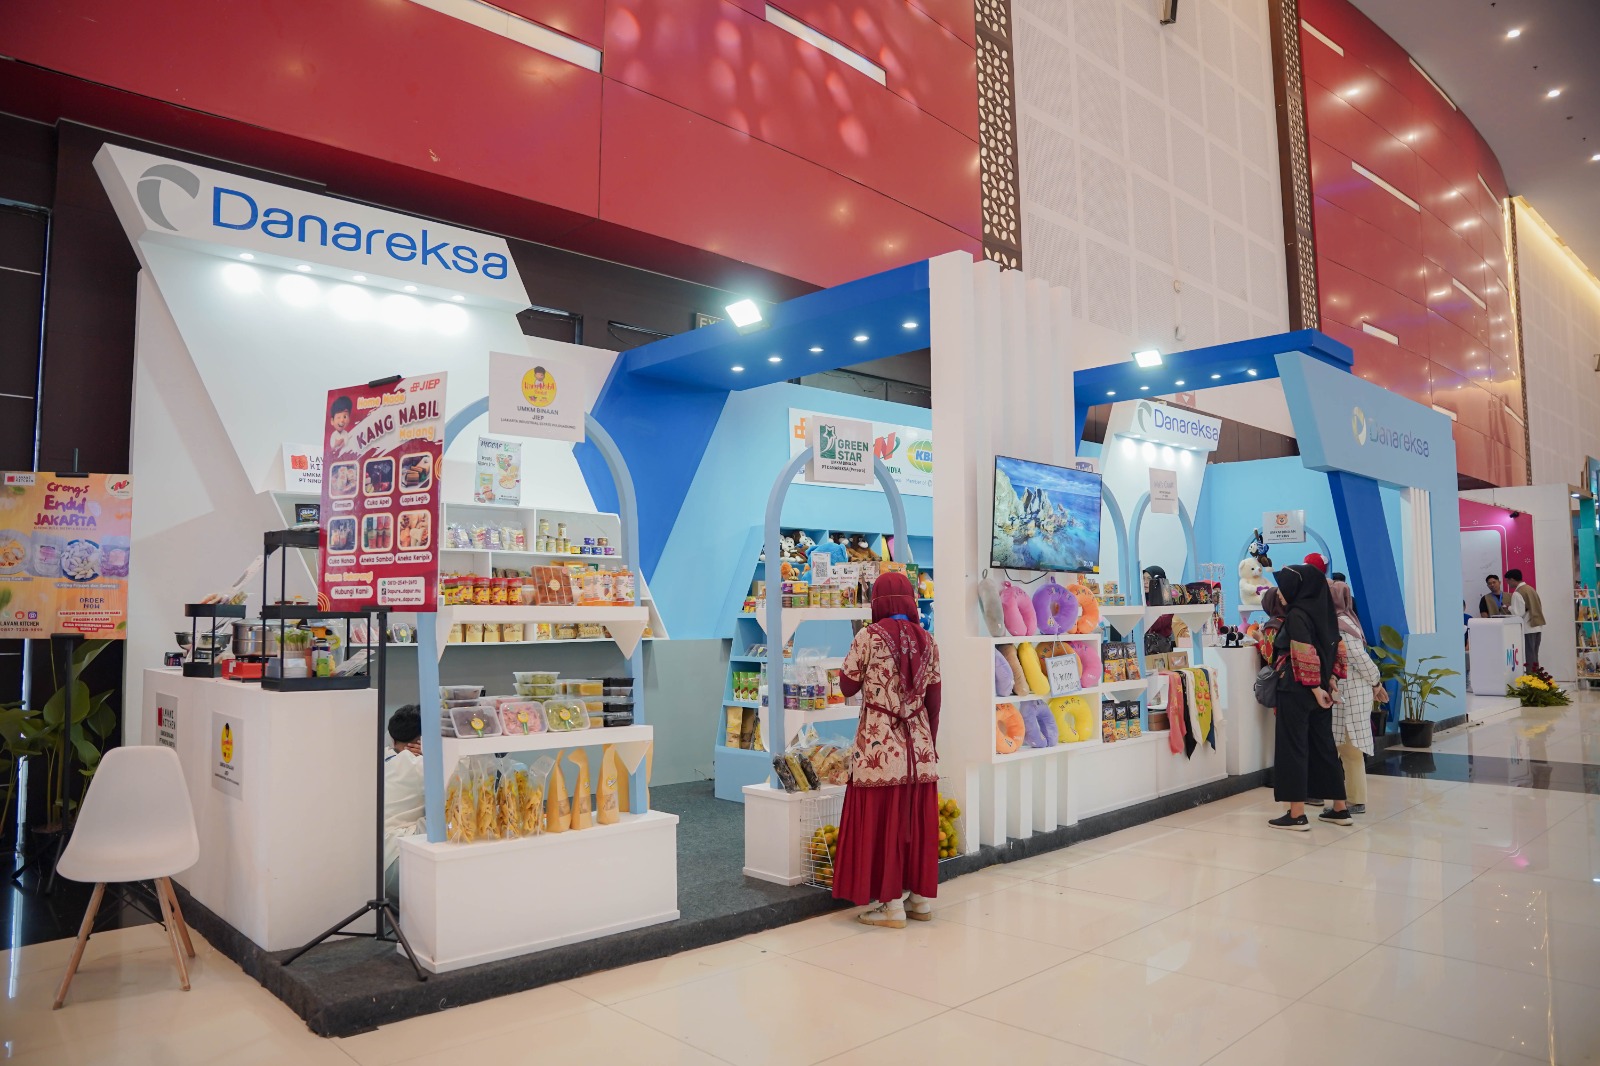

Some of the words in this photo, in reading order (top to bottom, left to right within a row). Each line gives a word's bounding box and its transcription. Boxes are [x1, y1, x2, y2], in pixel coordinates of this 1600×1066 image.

[212, 186, 508, 280] Danareksa
[419, 379, 441, 391] JIEP
[357, 397, 381, 409] Home
[382, 391, 405, 406] Made
[536, 408, 559, 416] BINAAN
[357, 415, 393, 449] KANG
[399, 400, 439, 425] NABIL
[1154, 408, 1219, 441] Danareksa
[399, 426, 434, 441] Malang
[1369, 418, 1430, 458] Danareksa
[838, 439, 869, 452] GREEN
[837, 450, 862, 462] STAR
[915, 449, 933, 462] KB
[401, 496, 414, 504] Lapis
[33, 513, 97, 526] JAKARTA
[413, 553, 430, 561] Keripik
[334, 588, 354, 597] Hubungi
